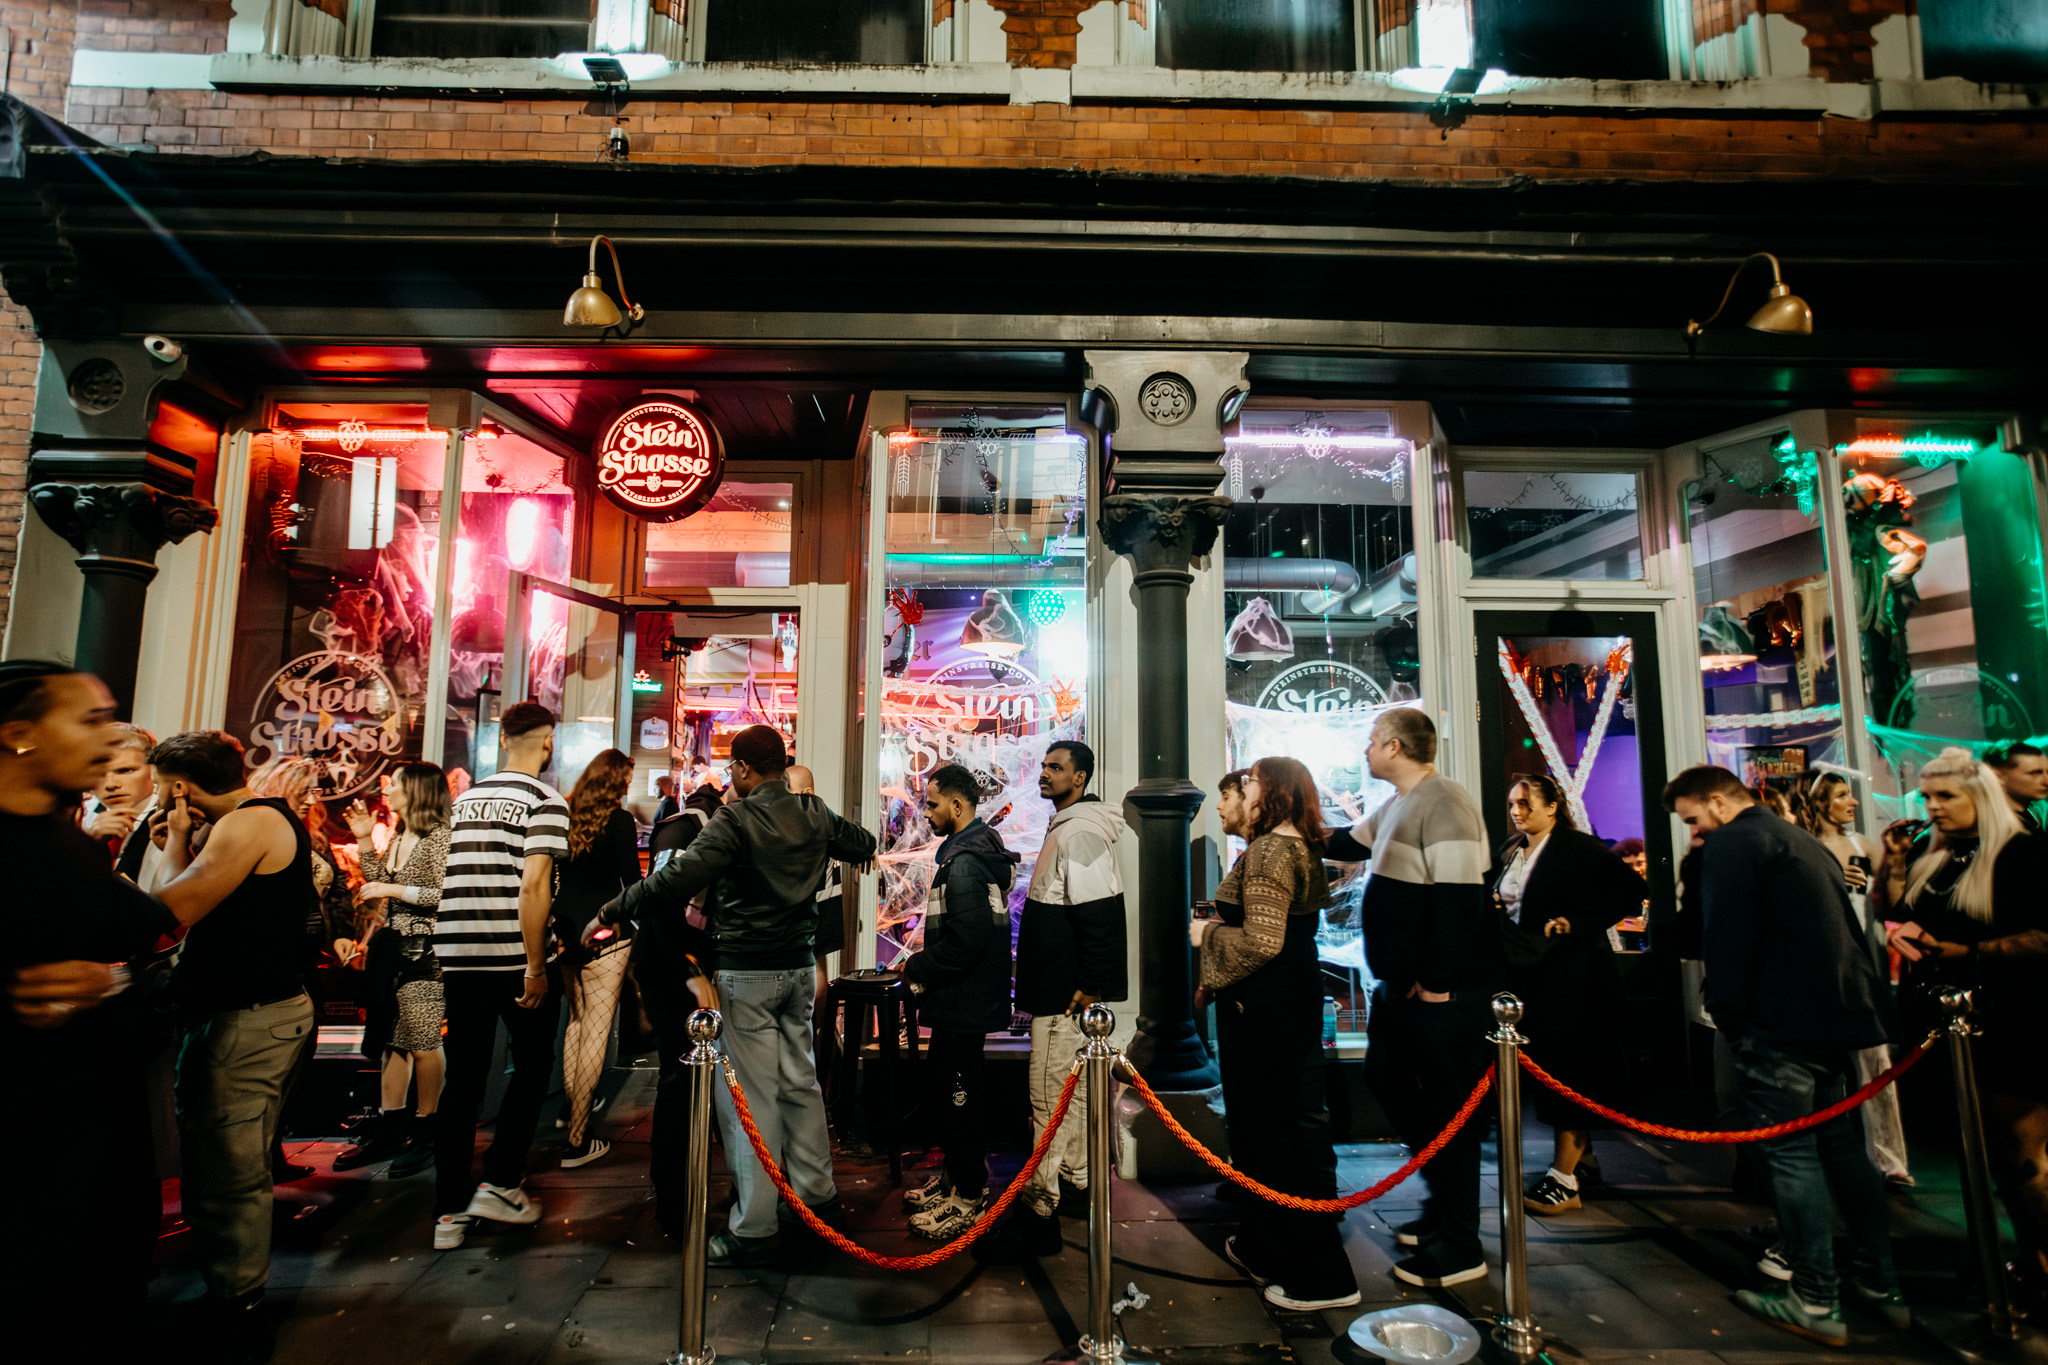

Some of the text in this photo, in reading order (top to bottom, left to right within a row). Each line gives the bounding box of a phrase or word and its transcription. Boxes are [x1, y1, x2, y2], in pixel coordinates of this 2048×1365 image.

[620, 421, 697, 451] Stein
[599, 450, 711, 484] Strasse
[624, 489, 684, 502] ETABLIERT 2017
[275, 677, 388, 721] Stein
[931, 684, 1042, 727] Stein
[244, 721, 403, 769] Strasse
[904, 729, 1036, 776] Strass
[457, 801, 525, 824] RISONER
